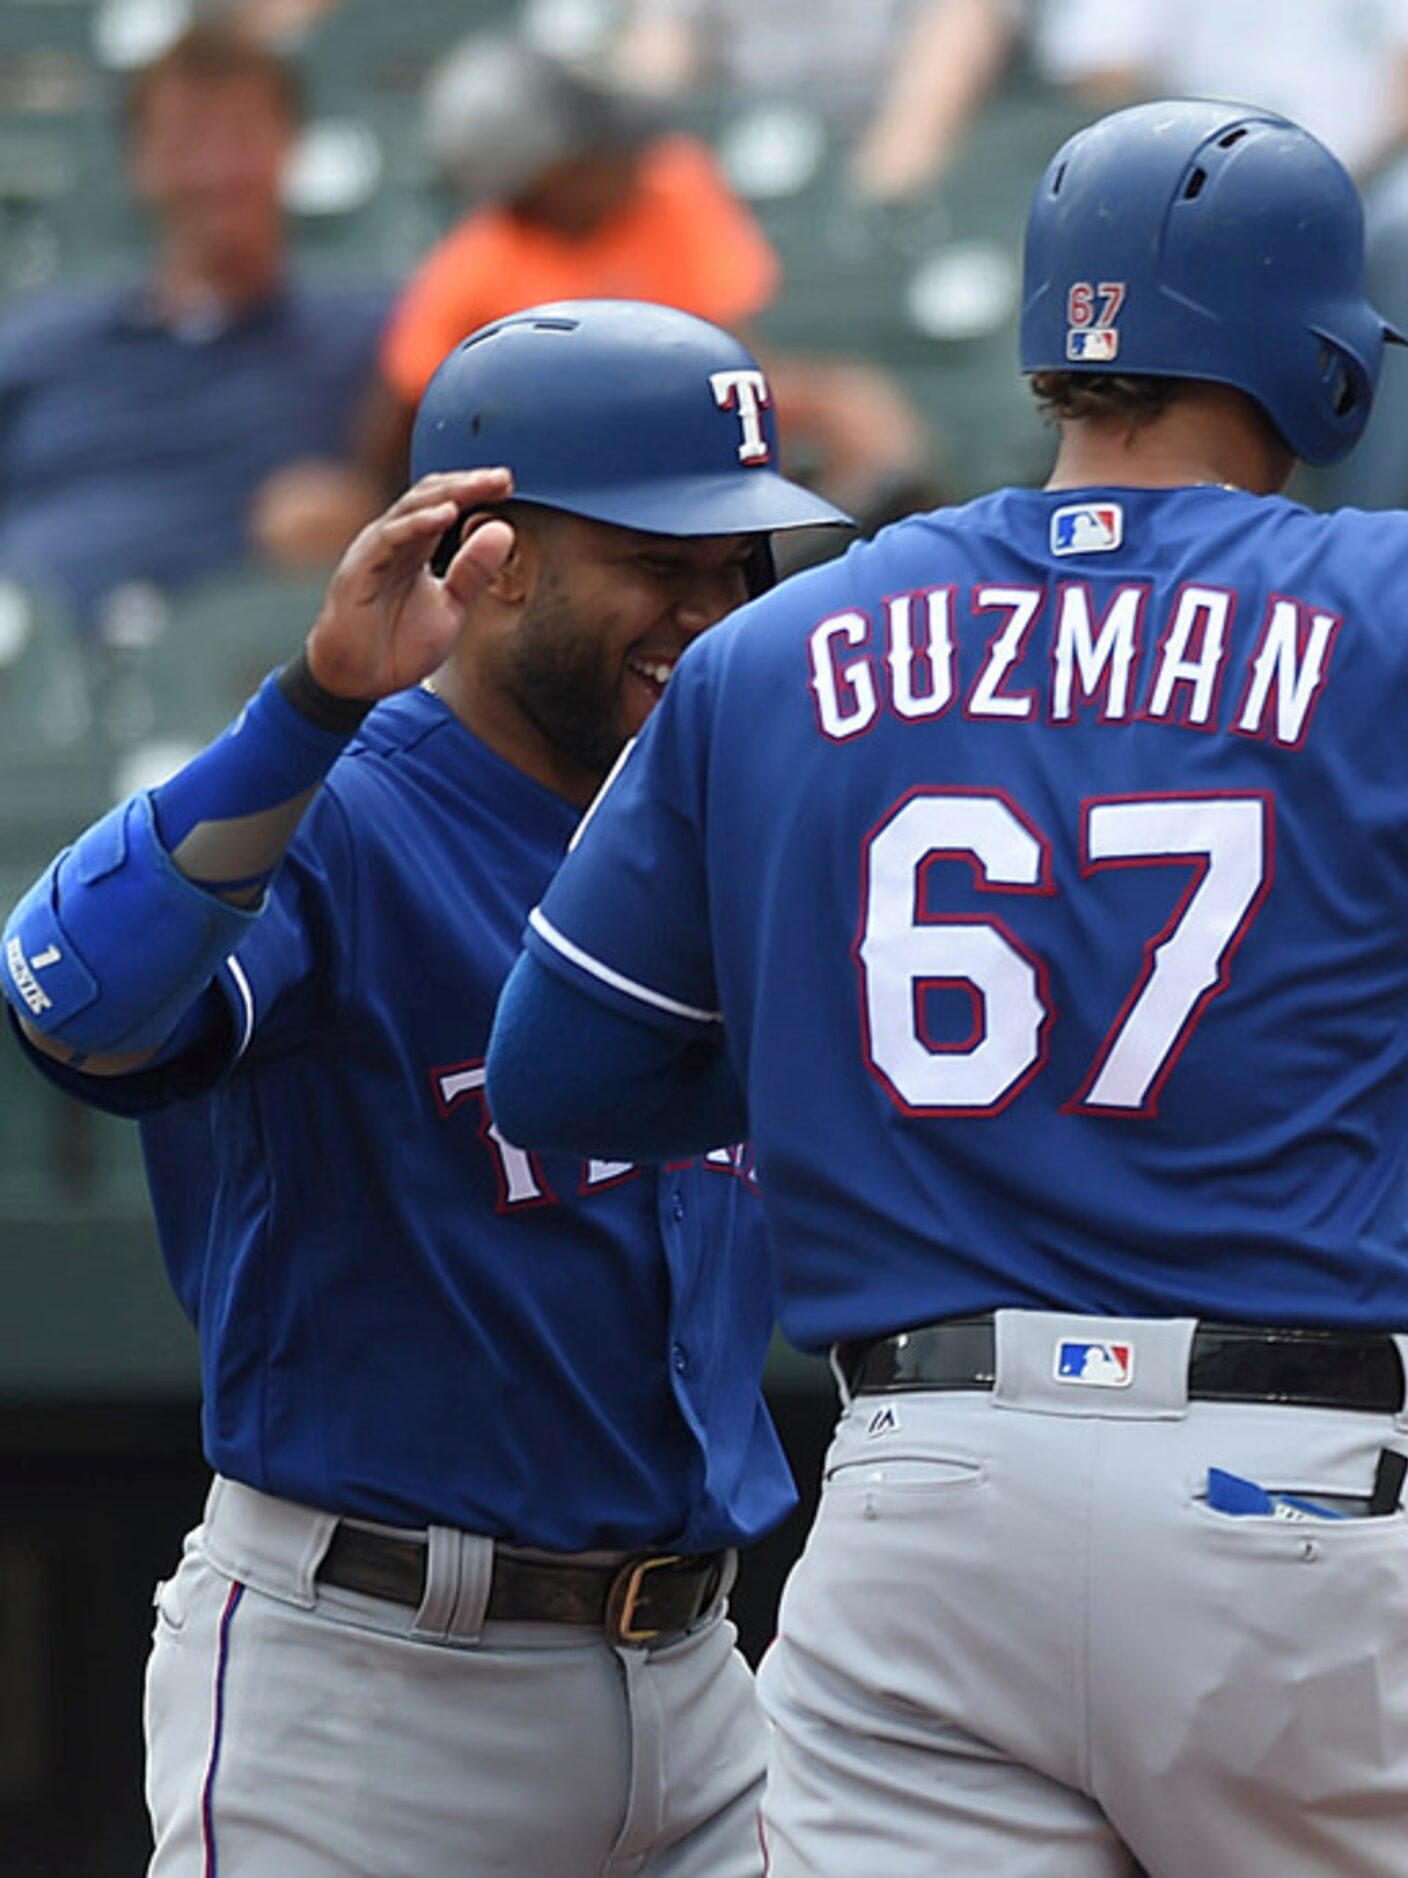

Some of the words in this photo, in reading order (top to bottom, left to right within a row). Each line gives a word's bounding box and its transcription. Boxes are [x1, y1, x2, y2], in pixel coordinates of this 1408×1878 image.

[1067, 281, 1127, 328] 67
[708, 369, 772, 466] T
[807, 582, 1342, 750] GUZMAN
[851, 784, 1273, 1117] 67
